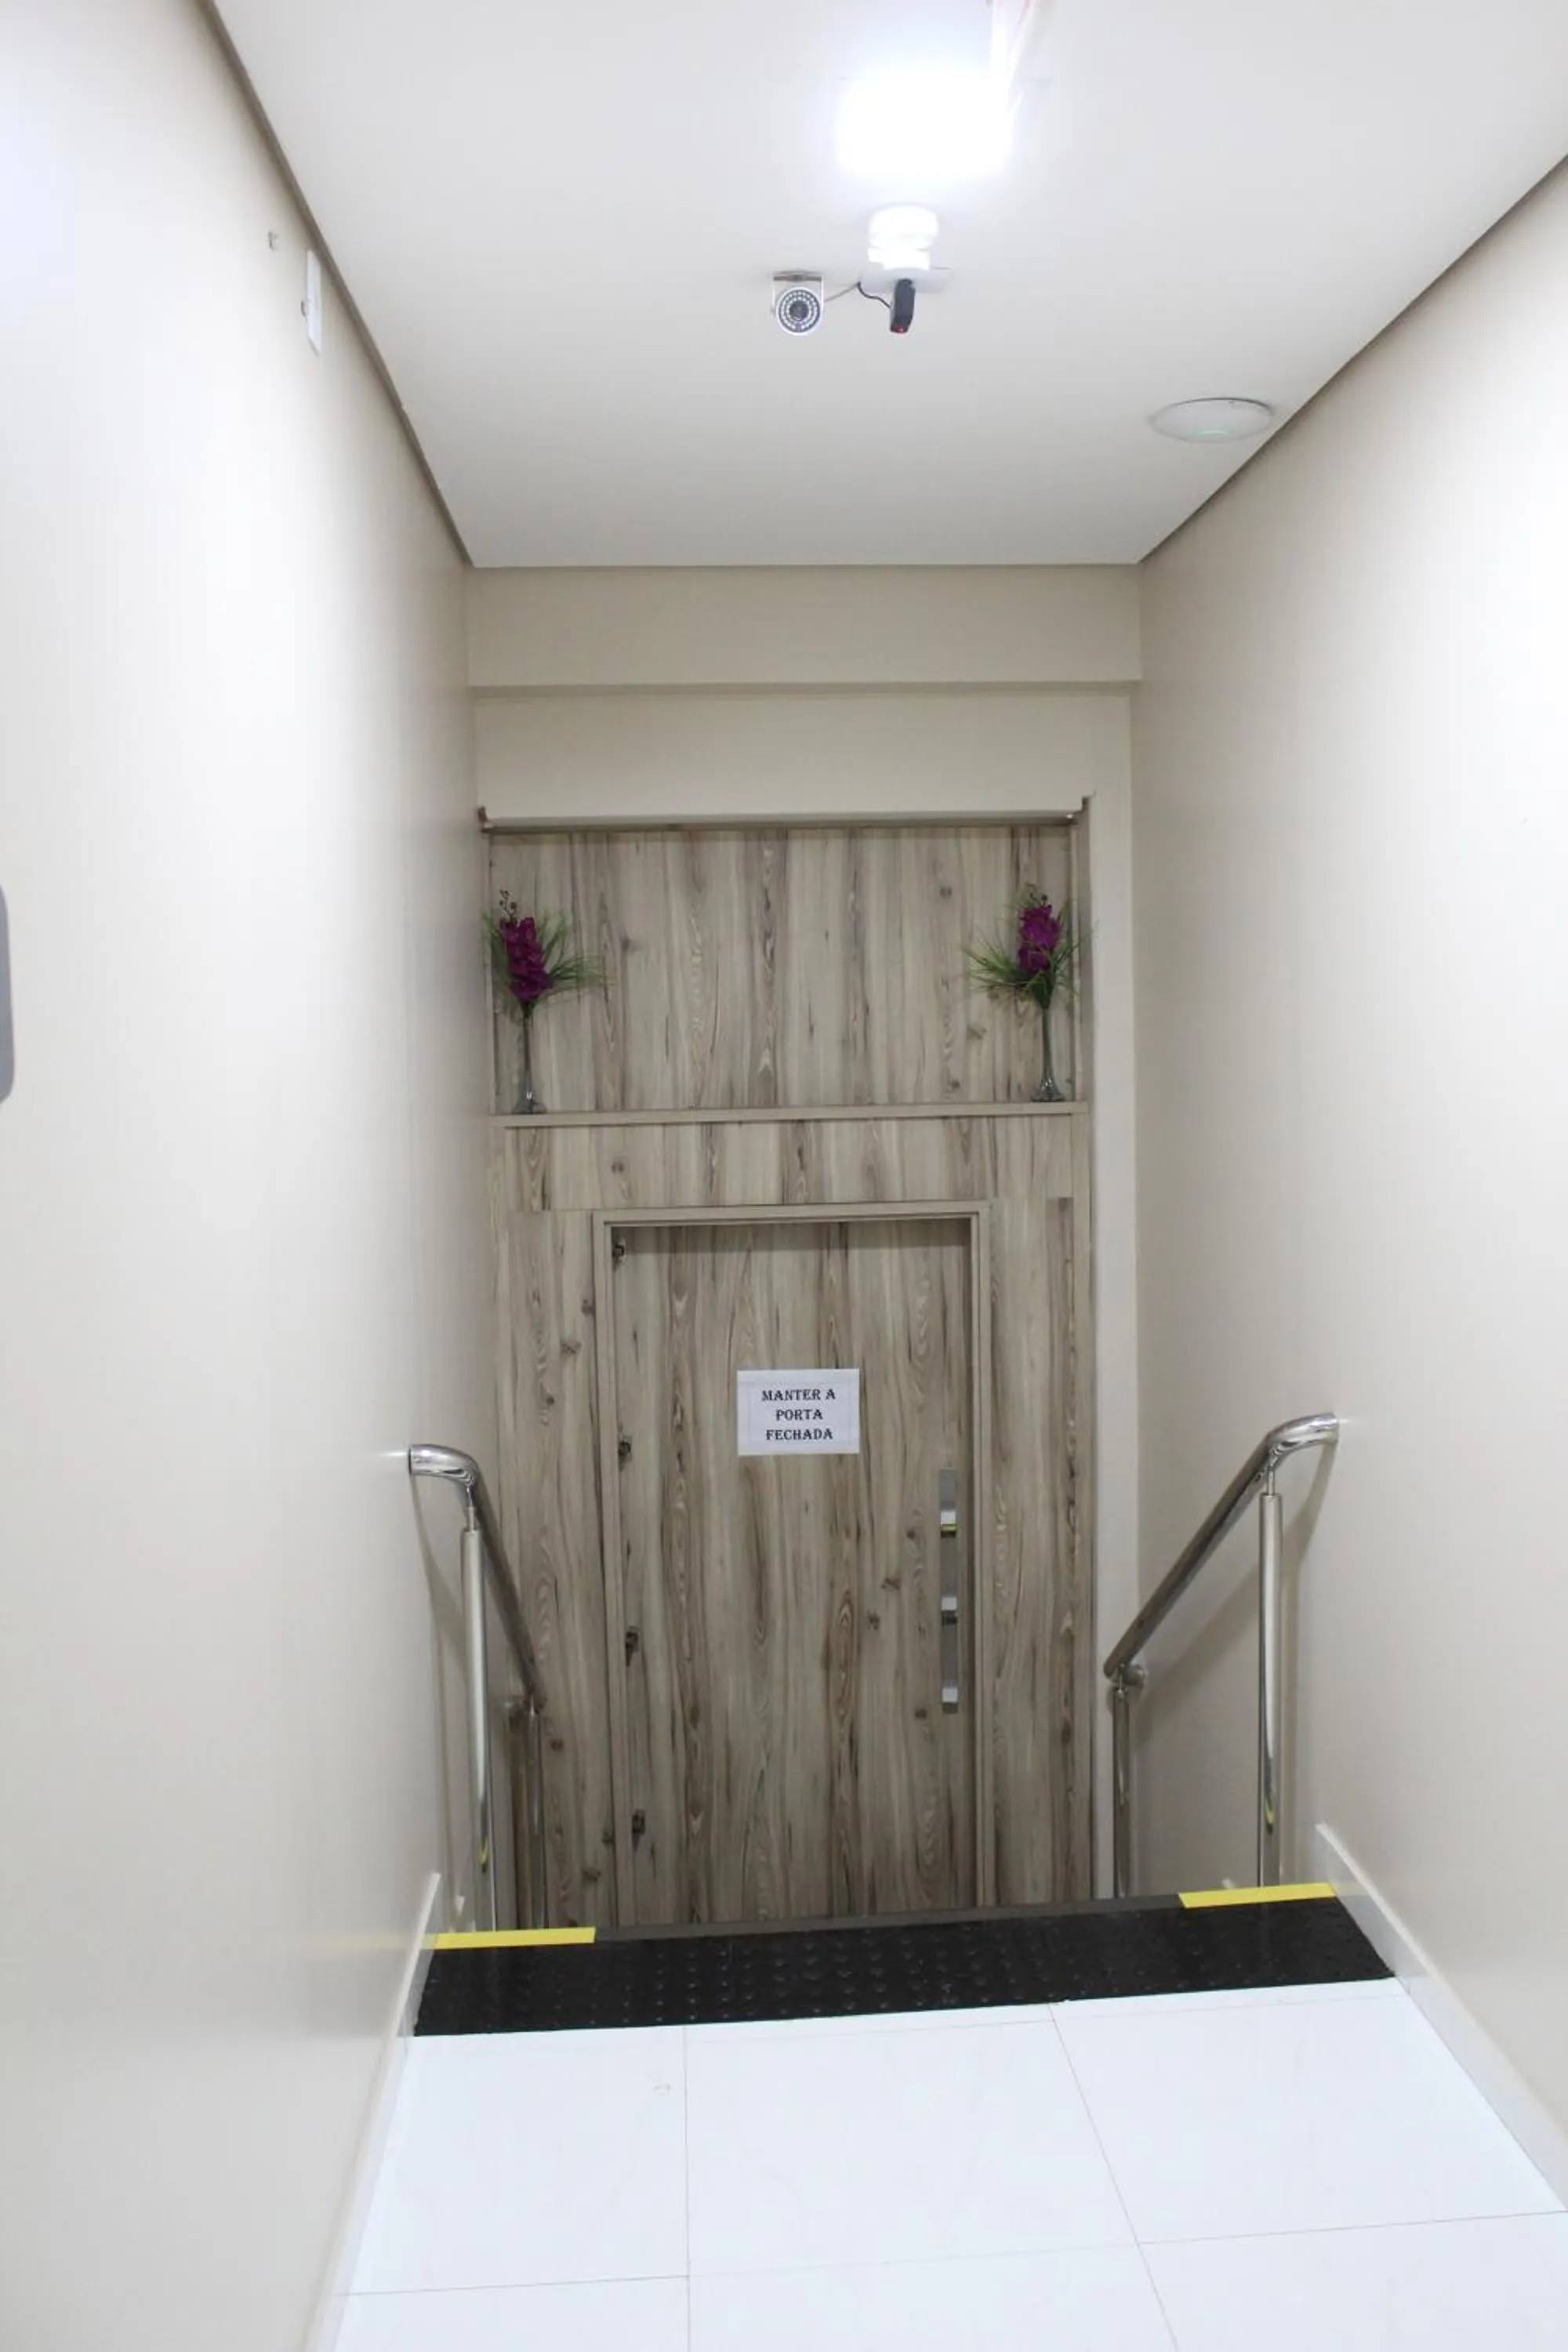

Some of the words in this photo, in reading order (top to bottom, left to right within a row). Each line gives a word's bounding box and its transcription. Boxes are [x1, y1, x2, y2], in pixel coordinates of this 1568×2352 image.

[761, 1388, 822, 1402] MANTER
[825, 1388, 837, 1400] A
[775, 1409, 823, 1421] PORTA
[765, 1428, 833, 1441] FECHADA
